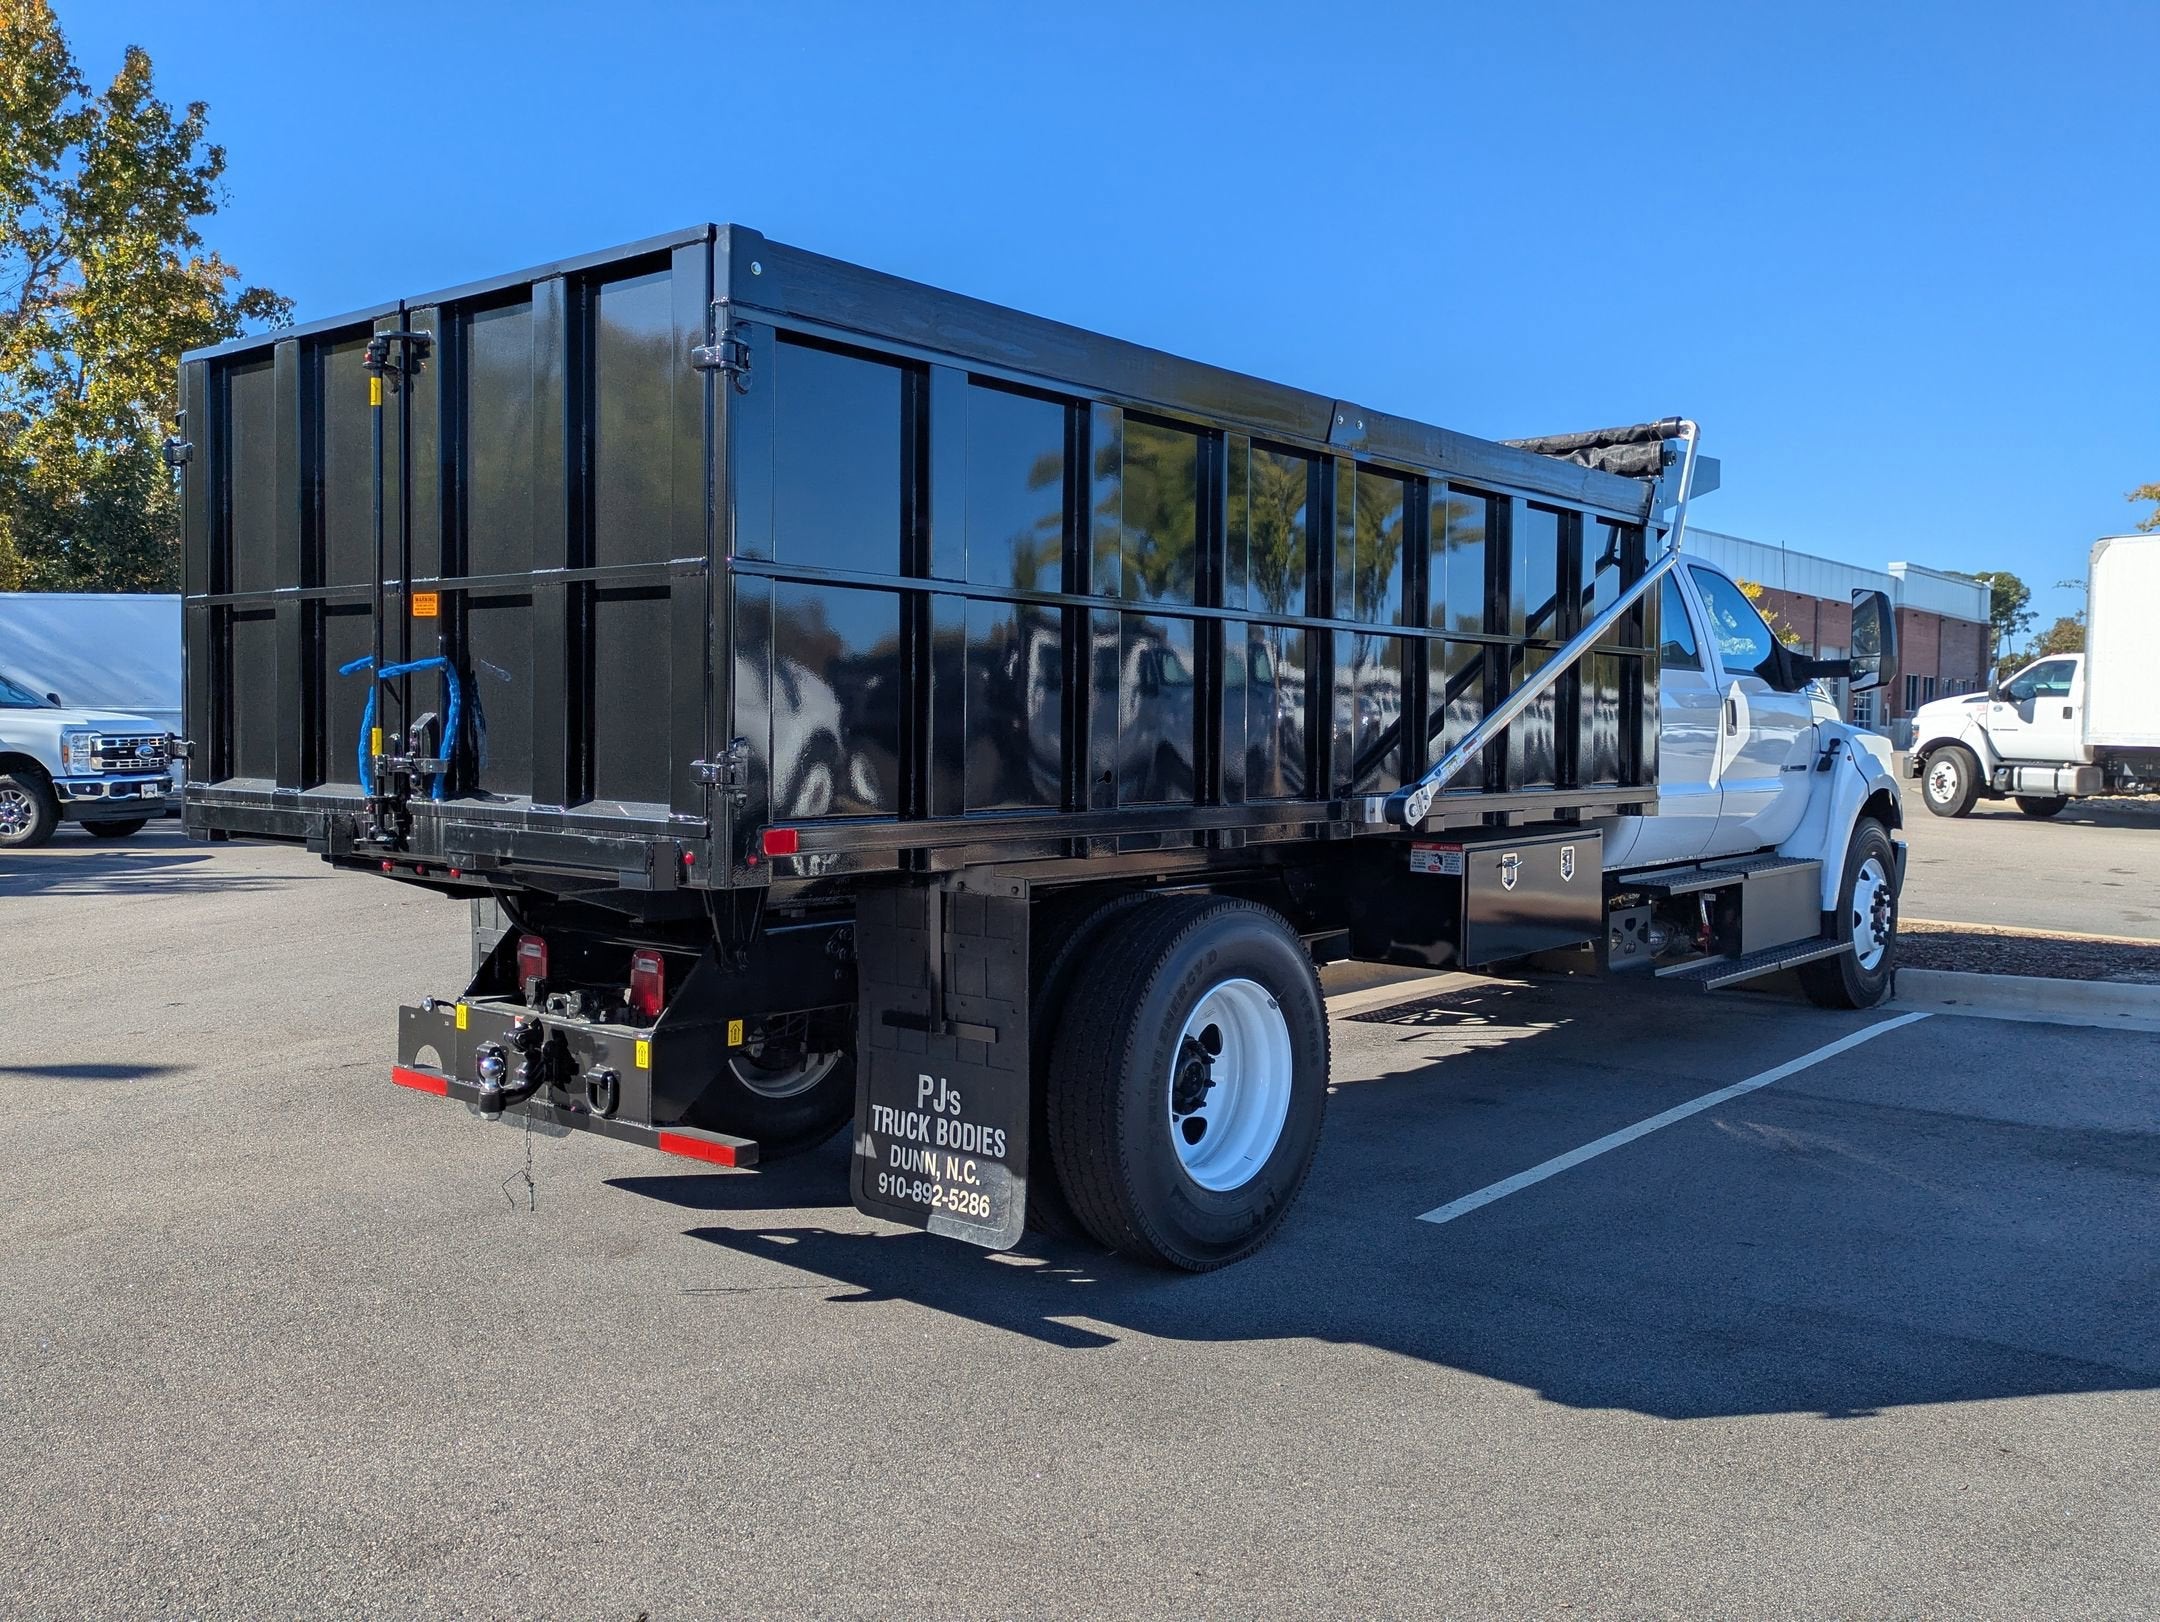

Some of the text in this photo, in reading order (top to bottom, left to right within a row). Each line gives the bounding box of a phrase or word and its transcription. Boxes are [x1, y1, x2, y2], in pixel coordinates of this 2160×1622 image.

[917, 1074, 961, 1116] PJ's
[872, 1104, 1006, 1158] TRUCK BODIES
[889, 1144, 981, 1186] DUNN, N.C.
[878, 1172, 990, 1218] 910-892-5286
